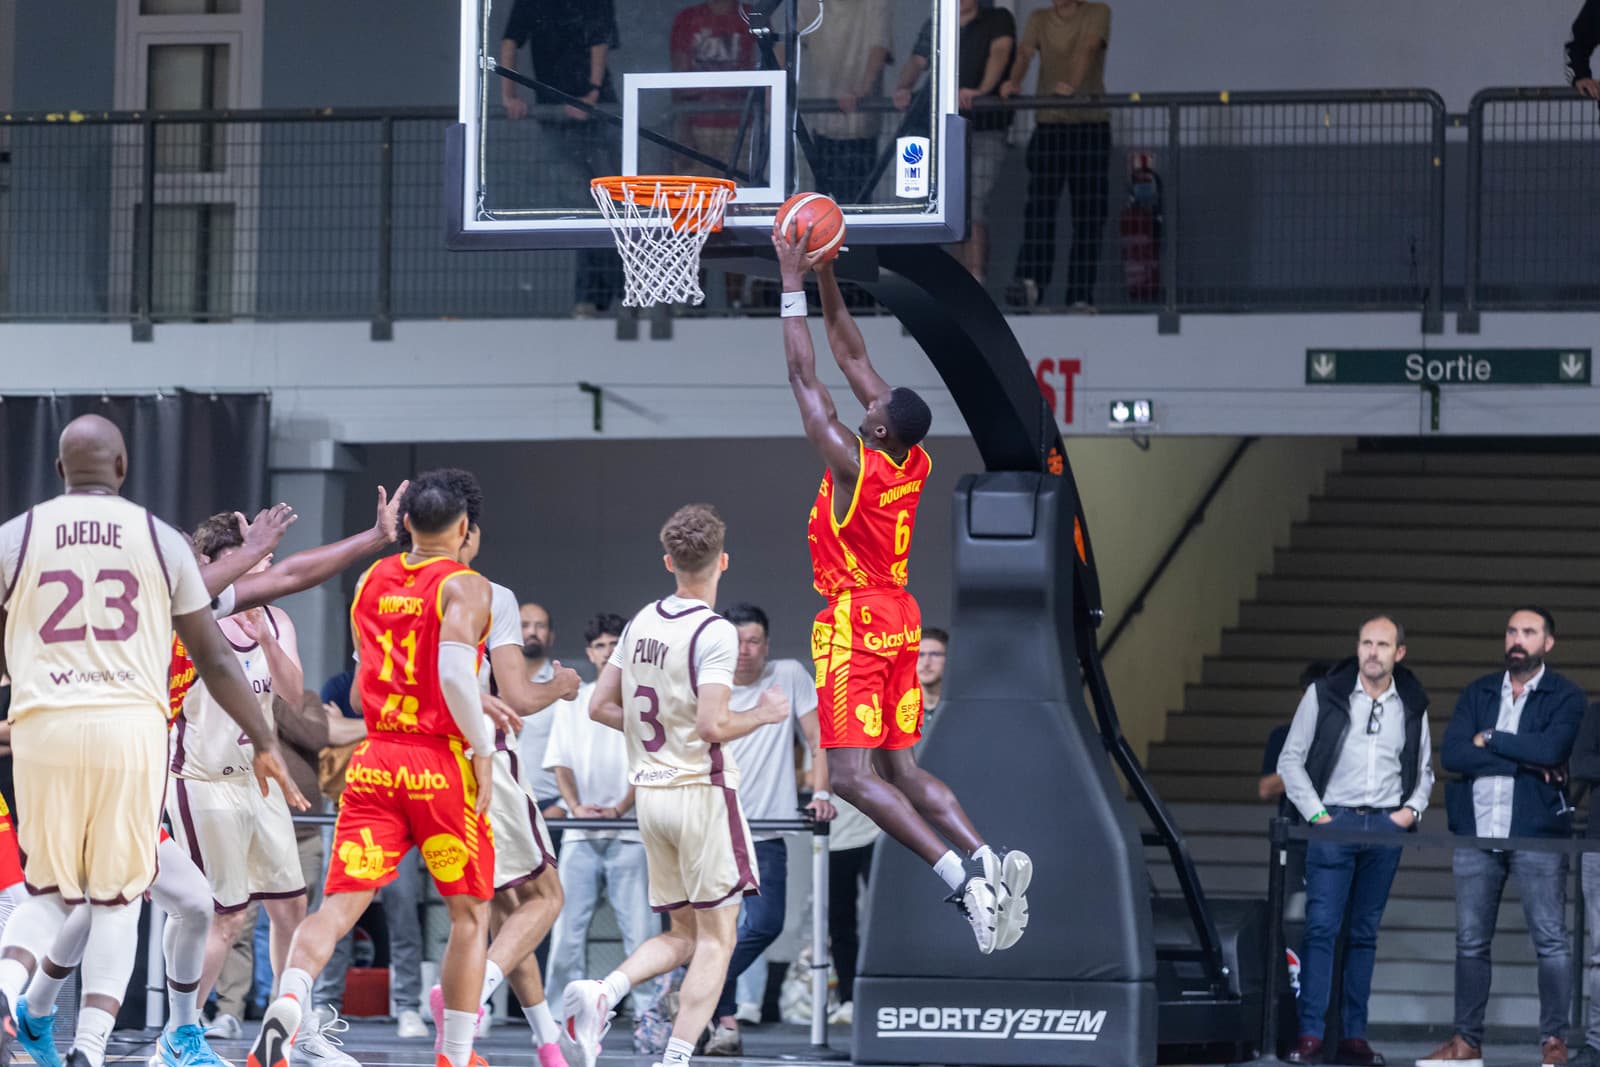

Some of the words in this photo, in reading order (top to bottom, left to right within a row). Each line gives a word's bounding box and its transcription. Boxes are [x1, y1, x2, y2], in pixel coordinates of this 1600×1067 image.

[1405, 353, 1492, 382] Sortie
[1033, 357, 1082, 425] ST
[56, 520, 123, 550] DJEDJE
[894, 509, 911, 556] 6
[37, 568, 140, 645] 23
[861, 605, 873, 625] 6
[375, 628, 418, 686] 11
[632, 637, 670, 671] PLUVY
[633, 684, 667, 753] 3
[876, 1006, 1108, 1040] SPORTSYSTEM
